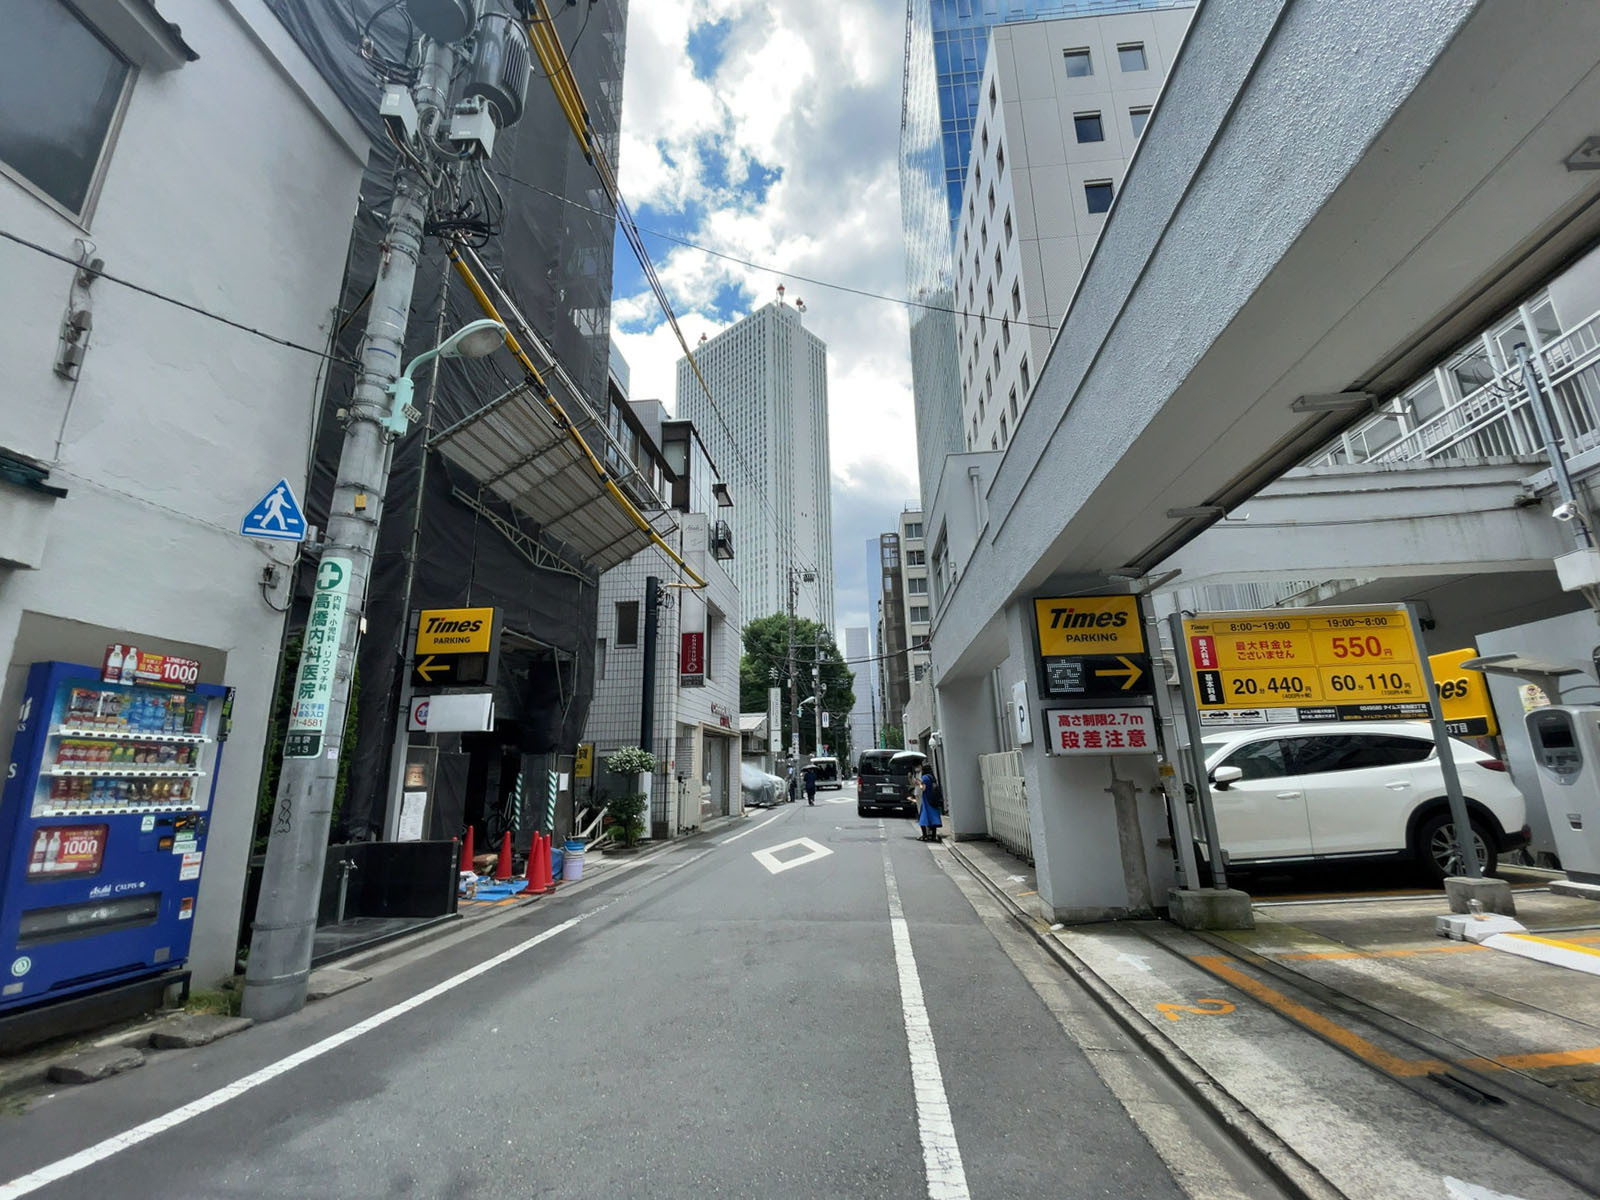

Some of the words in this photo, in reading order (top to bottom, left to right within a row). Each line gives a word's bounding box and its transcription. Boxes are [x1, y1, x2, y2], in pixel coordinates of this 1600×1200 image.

[425, 617, 483, 634] Times
[1050, 608, 1128, 629] Times
[298, 593, 332, 699] 高橋内科医院
[433, 636, 470, 645] PARKING
[1066, 633, 1118, 642] PARKING
[1235, 640, 1292, 650] 最大料金は
[1237, 650, 1295, 660] ございません
[164, 663, 198, 681] 1000
[1047, 659, 1085, 692] 空
[1061, 729, 1147, 749] 段差注意
[63, 840, 98, 855] 1000
